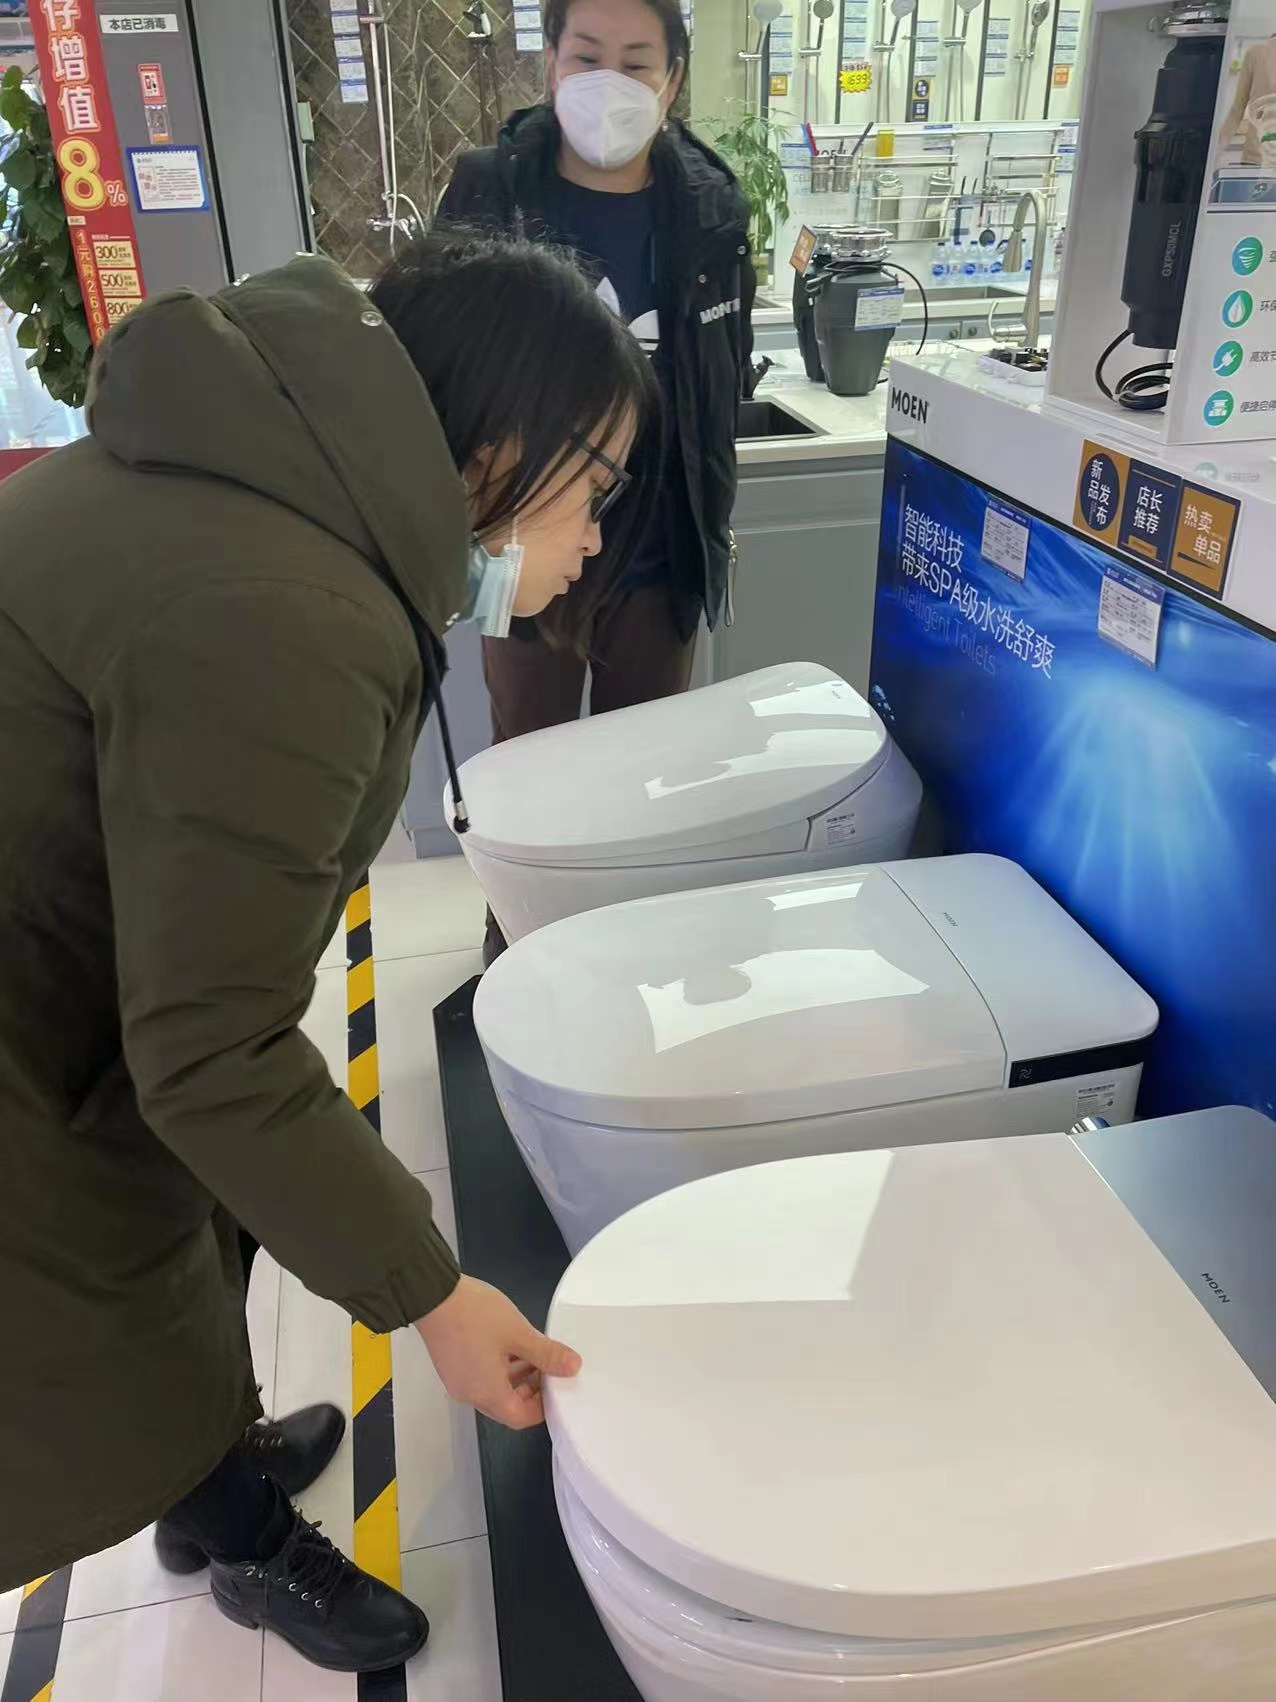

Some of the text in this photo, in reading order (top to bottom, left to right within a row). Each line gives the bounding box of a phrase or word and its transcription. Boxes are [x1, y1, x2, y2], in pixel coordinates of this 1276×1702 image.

[108, 17, 168, 31] 本店已消毒
[95, 245, 119, 260] 300
[101, 273, 124, 288] 500
[106, 302, 129, 316] 800
[891, 387, 928, 425] MOEN
[1136, 485, 1164, 513] 店长
[1133, 506, 1161, 535] 推荐
[1183, 503, 1213, 535] 热卖
[904, 503, 965, 574] 智能科技
[1193, 534, 1222, 565] 单品
[901, 542, 1056, 680] 带来SPA级水洗舒爽
[1200, 1272, 1231, 1304] MOEN
